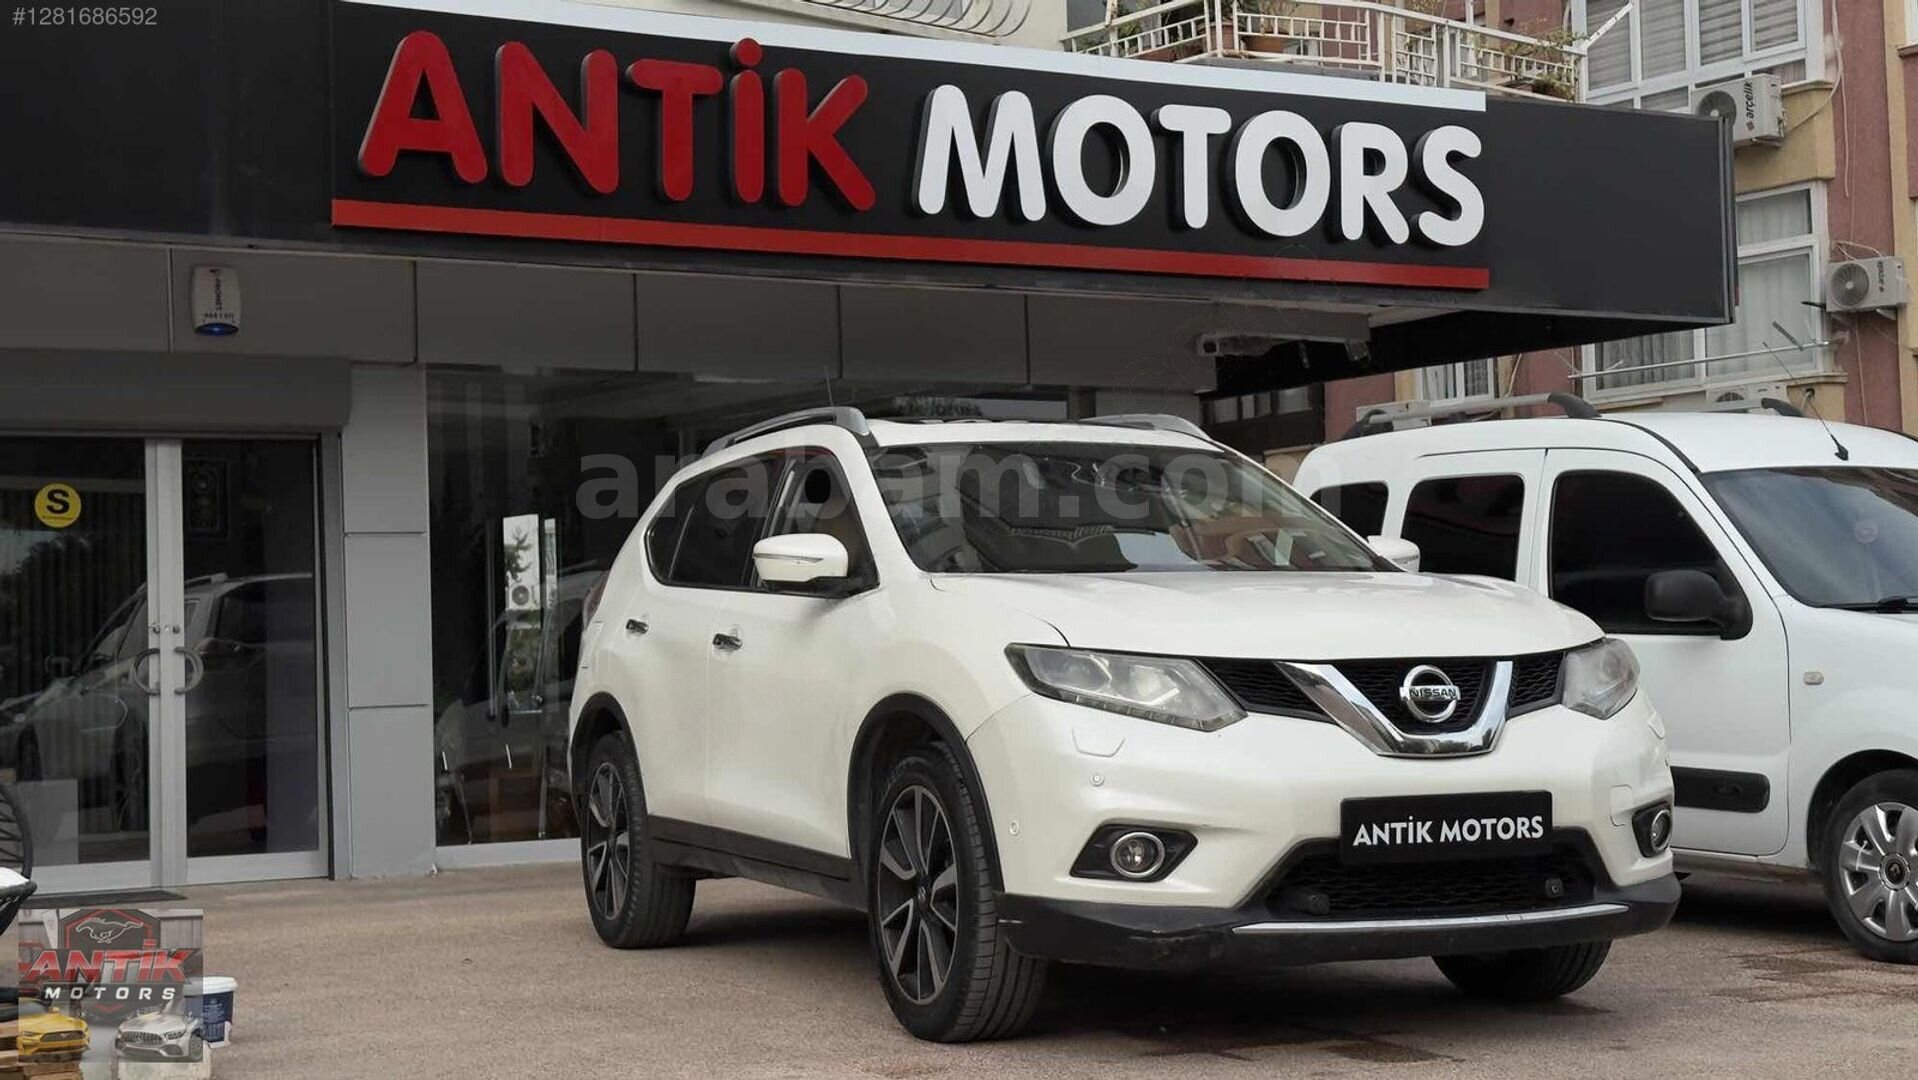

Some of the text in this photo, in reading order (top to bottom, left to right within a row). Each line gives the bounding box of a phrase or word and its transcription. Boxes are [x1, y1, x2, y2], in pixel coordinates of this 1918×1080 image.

[1743, 81, 1755, 119] arçelik
[915, 84, 1486, 247] MOTORS
[46, 489, 70, 515] S
[1409, 687, 1457, 698] NISSAN
[1353, 815, 1545, 846] ANTİK MOTORS
